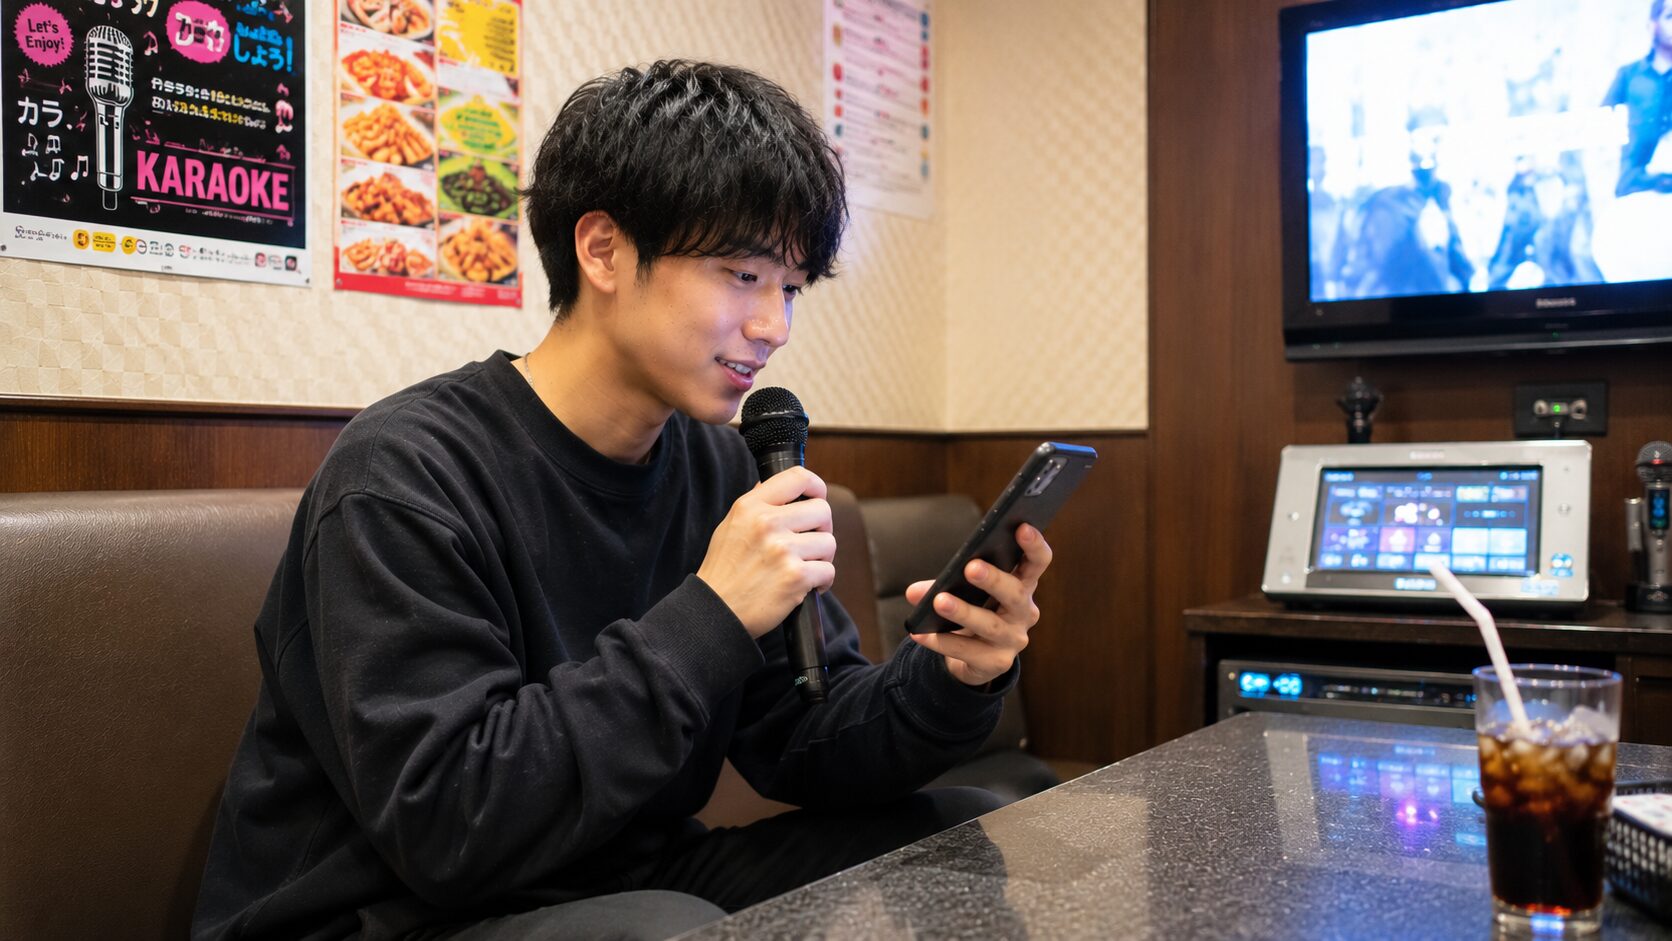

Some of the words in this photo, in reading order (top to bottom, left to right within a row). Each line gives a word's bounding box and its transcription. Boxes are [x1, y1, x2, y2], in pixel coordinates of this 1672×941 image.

[27, 18, 59, 34] Let's
[25, 35, 65, 54] Enjoy!
[136, 150, 290, 211] KARAOKE
